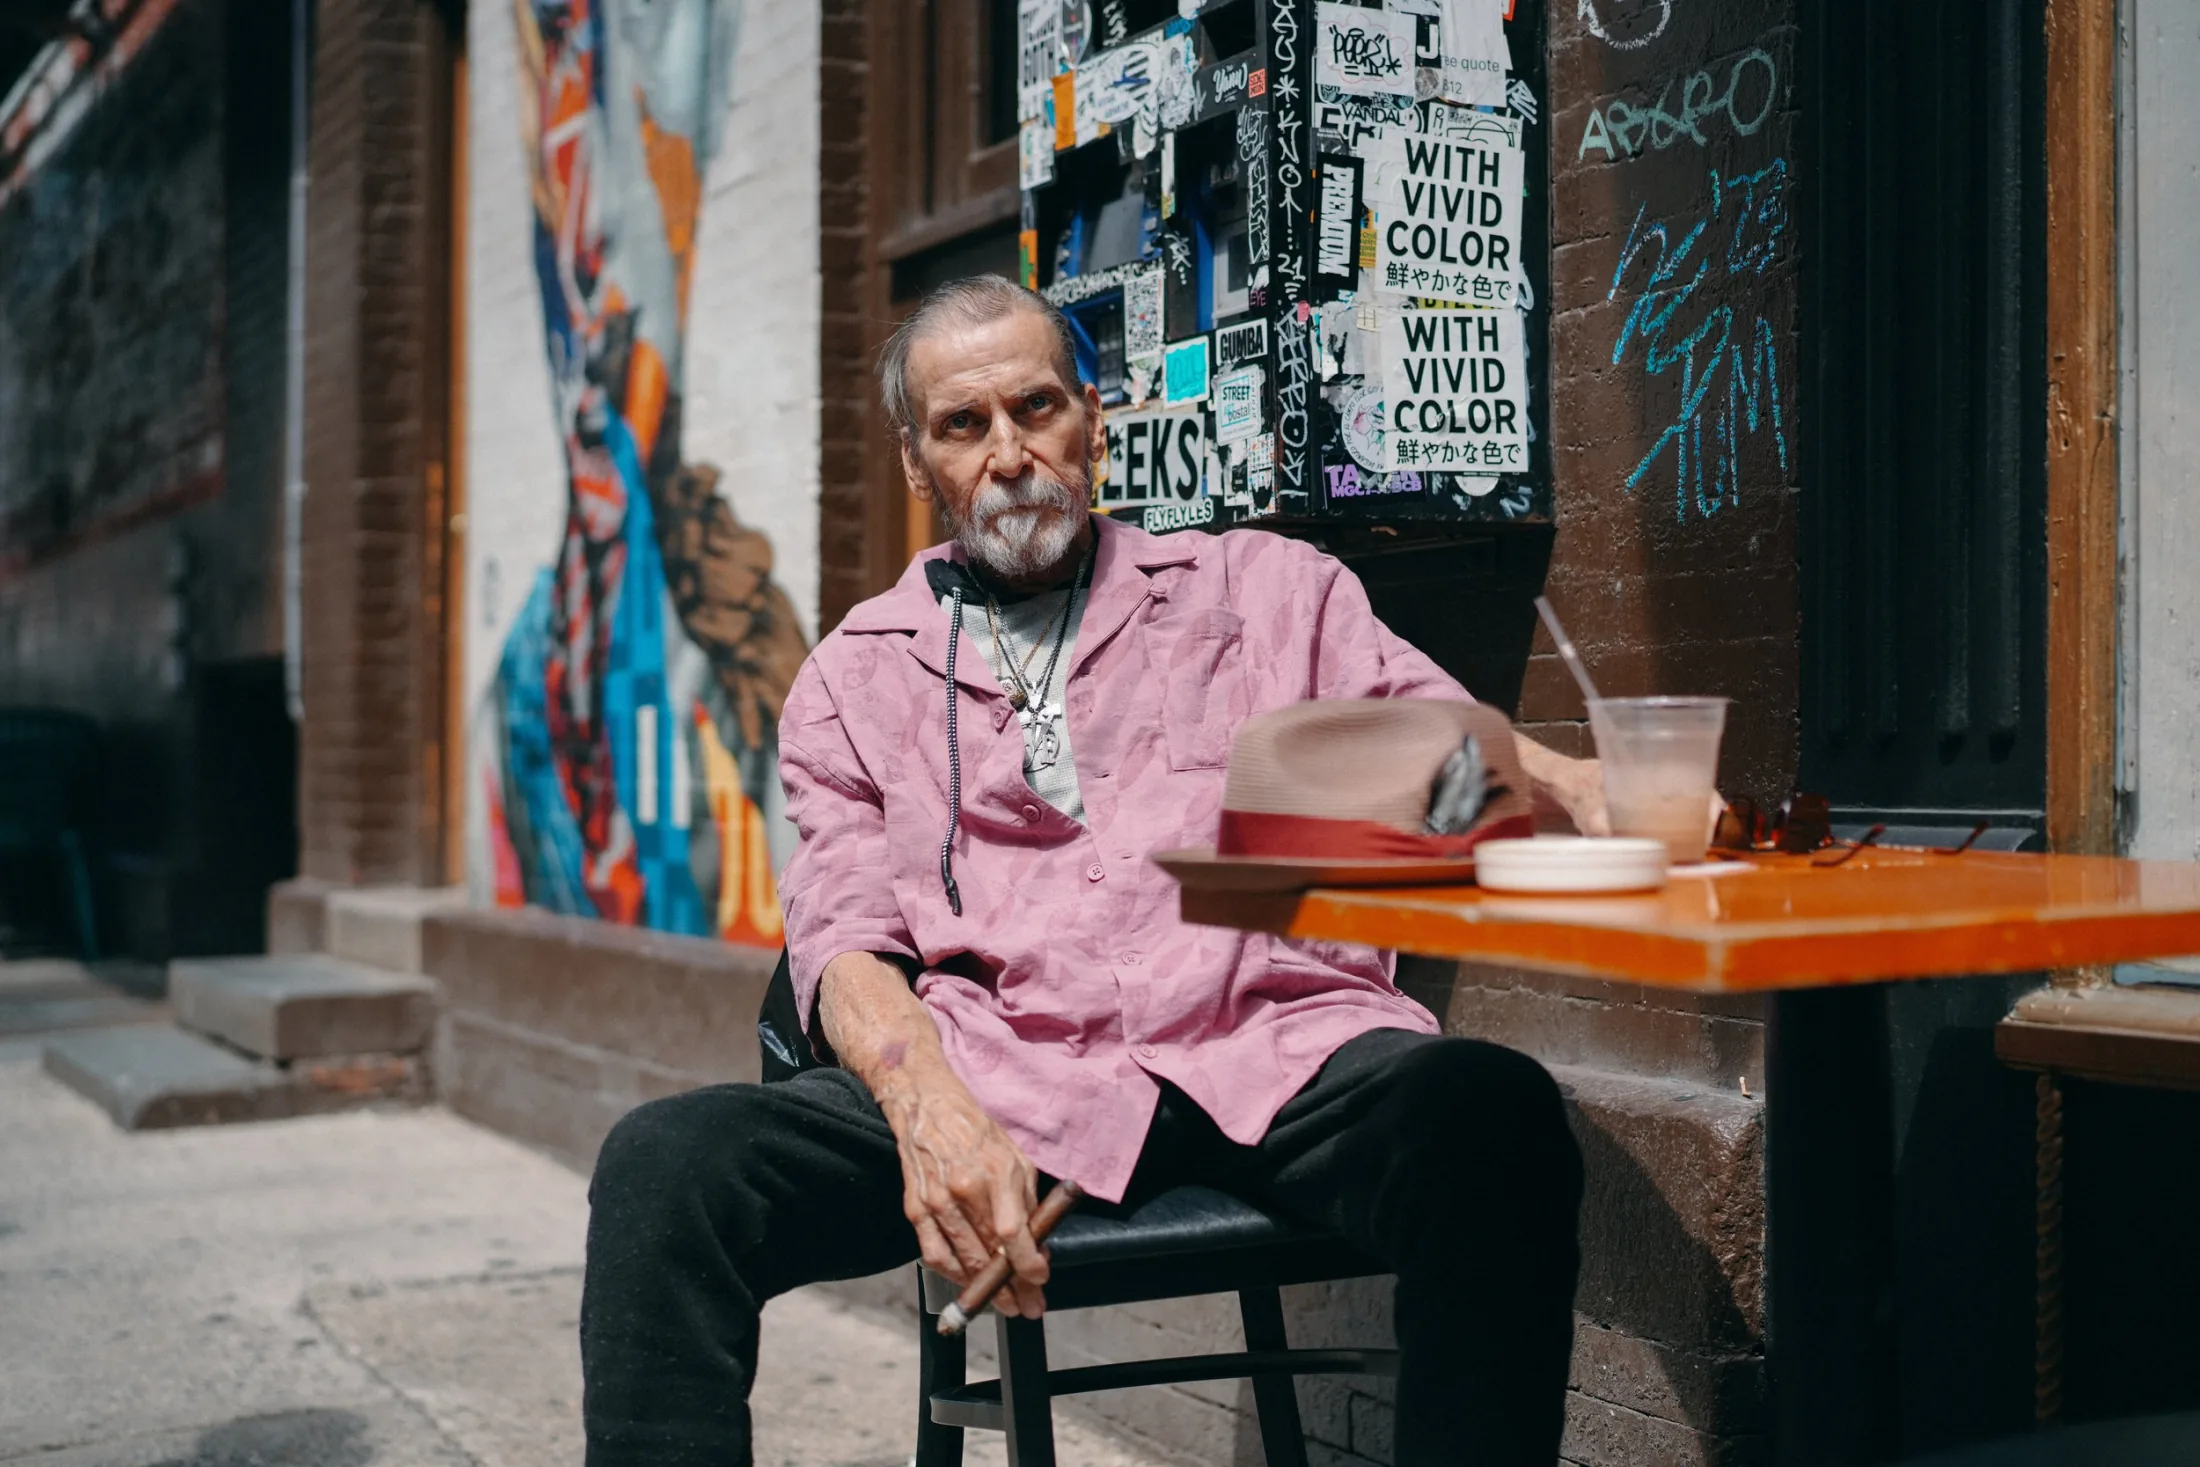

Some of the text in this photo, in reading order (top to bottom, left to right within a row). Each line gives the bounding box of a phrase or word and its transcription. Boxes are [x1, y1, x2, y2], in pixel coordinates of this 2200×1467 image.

[1461, 58, 1500, 72] quote
[1405, 138, 1499, 187] WITH
[1318, 163, 1355, 278] PREMIUM
[1401, 179, 1502, 227] VIVID
[1387, 220, 1510, 272] COLOR
[1386, 261, 1512, 301] 鮮やかな色で
[1220, 324, 1264, 362] GUMBA
[1402, 316, 1499, 352] WITH
[1222, 385, 1251, 401] STREET
[1403, 358, 1505, 394] VIVID
[1395, 399, 1517, 433] COLOR
[1103, 419, 1200, 501] LEKS
[1396, 439, 1521, 465] 鮮やかな色で
